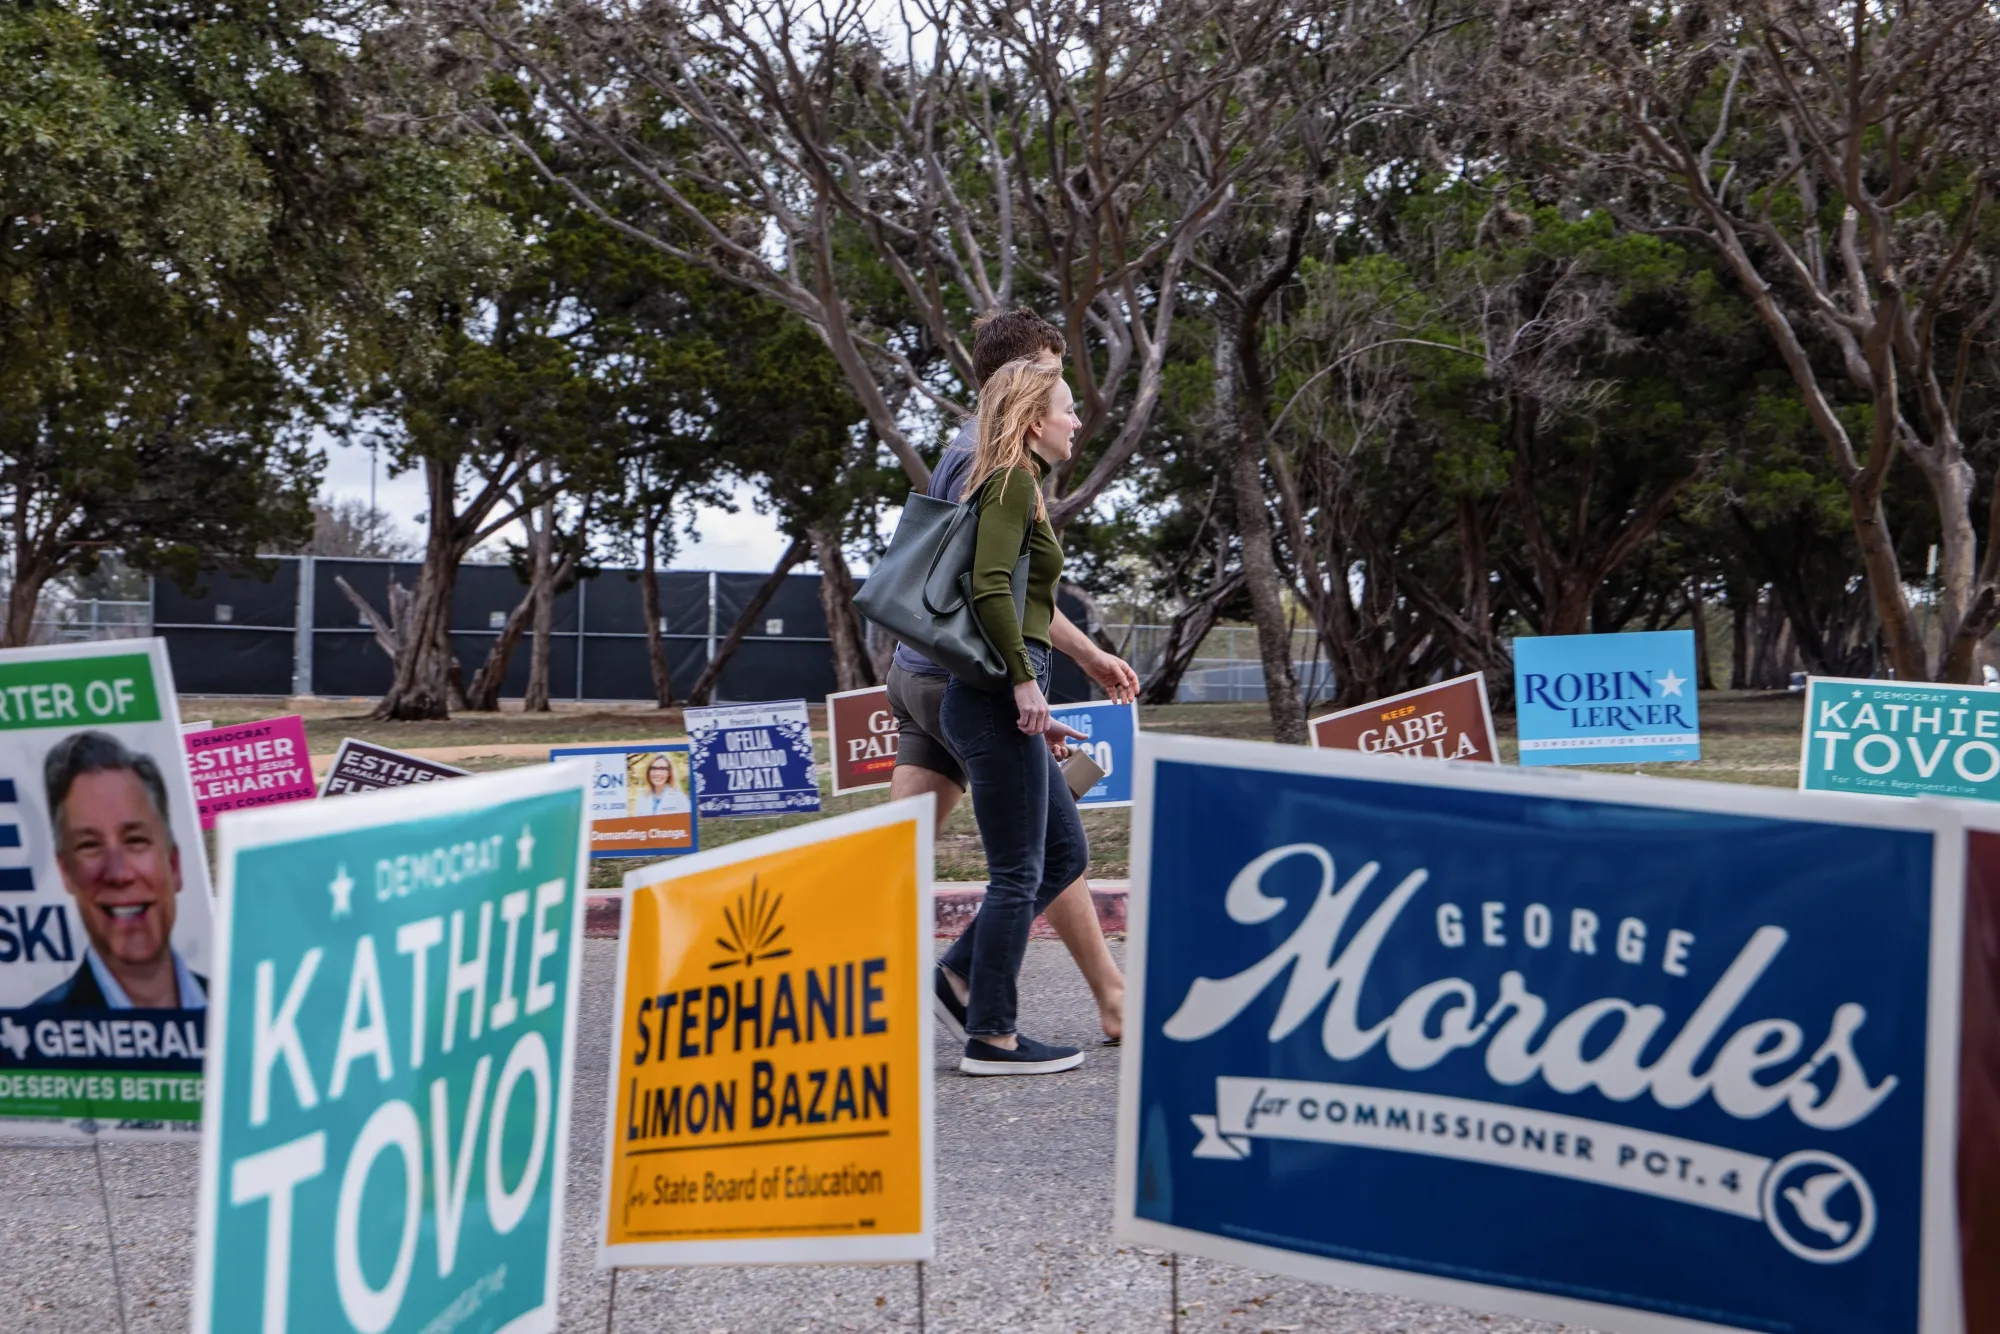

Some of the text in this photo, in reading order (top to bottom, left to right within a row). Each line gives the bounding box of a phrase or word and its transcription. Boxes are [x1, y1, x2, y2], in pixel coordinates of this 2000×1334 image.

[85, 678, 135, 717] OF
[1524, 670, 1654, 711] ROBIN
[1873, 691, 1948, 703] DEMOCRAT
[1358, 710, 1449, 754] GABE
[1380, 705, 1416, 721] KEEP
[1571, 704, 1693, 731] LERNER
[1819, 700, 2000, 739] KATHIE
[186, 738, 296, 772] ESTHER
[192, 727, 272, 747] DEMOCRAT
[725, 729, 773, 752] OFELIA
[1610, 737, 1635, 745] FOR
[1814, 730, 2000, 783] TOVO
[192, 759, 296, 782] MALIA DE JESUS
[340, 766, 386, 783] AMALIA
[726, 767, 784, 791] ZAPATA
[1832, 775, 1978, 794] For State Representative
[236, 788, 312, 808] CONGRESS
[376, 834, 503, 901] DEMOCRAT
[1436, 901, 1696, 977] GEORGE
[249, 876, 566, 1129] KATHIE
[1162, 843, 1899, 1130] Morales
[634, 957, 889, 1067] STEPHANIE
[34, 1018, 207, 1059] GENERAL
[0, 1074, 115, 1100] DESERVES
[627, 1059, 889, 1142] LIMON BAZAN
[1244, 1086, 1743, 1195] for COMMISSIONER PCT. 4
[229, 1031, 553, 1334] TOVO
[653, 1174, 698, 1206] State
[703, 1168, 757, 1204] Board
[760, 1166, 780, 1200] of
[784, 1162, 883, 1199] Education
